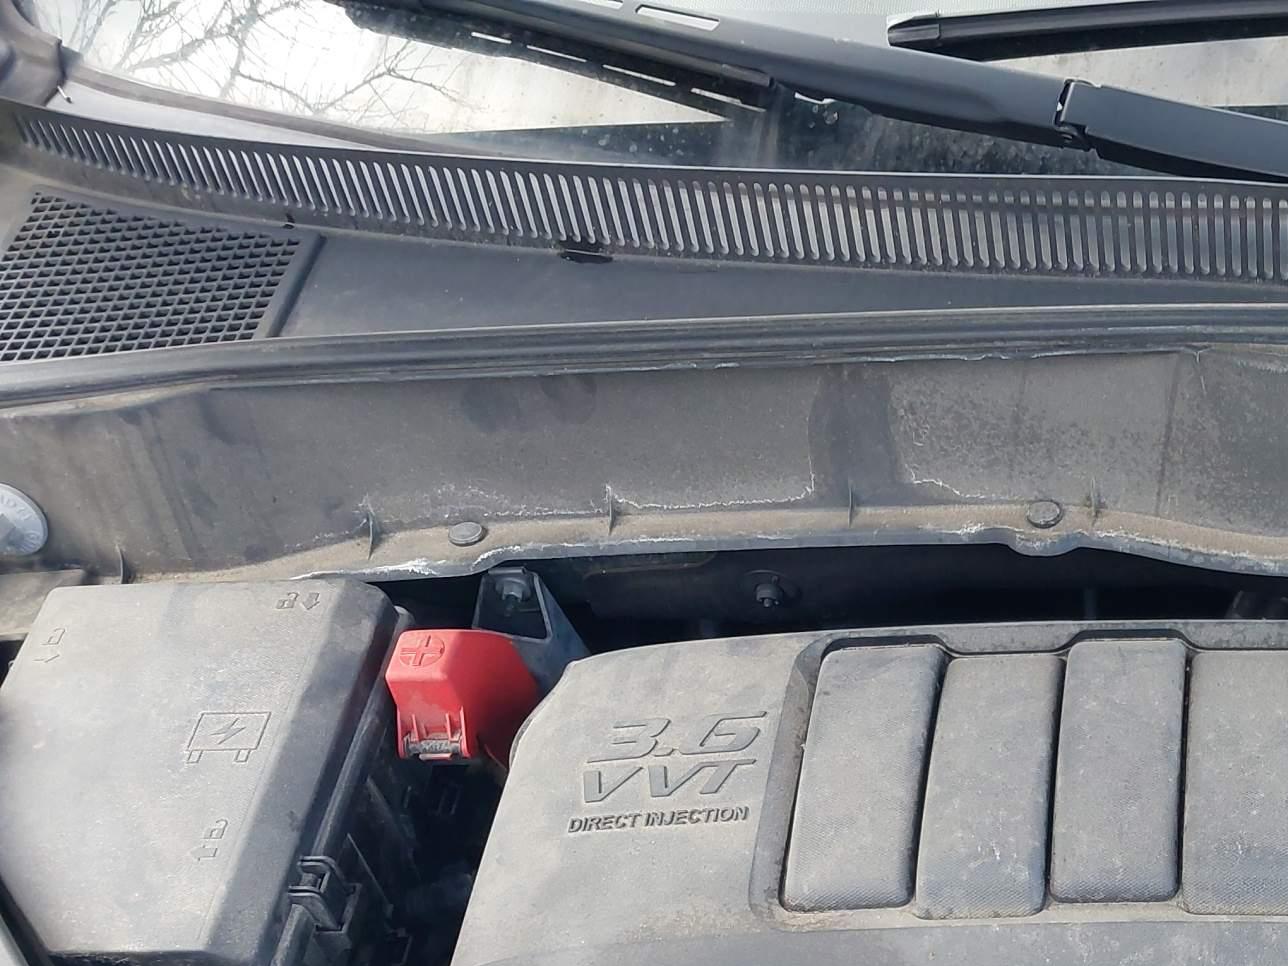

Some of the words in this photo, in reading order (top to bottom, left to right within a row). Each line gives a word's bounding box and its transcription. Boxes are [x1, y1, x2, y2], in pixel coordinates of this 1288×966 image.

[587, 710, 767, 763] 3.6
[583, 758, 757, 803] VVT
[568, 814, 640, 833] DIRECT
[645, 806, 750, 828] INJECTION
